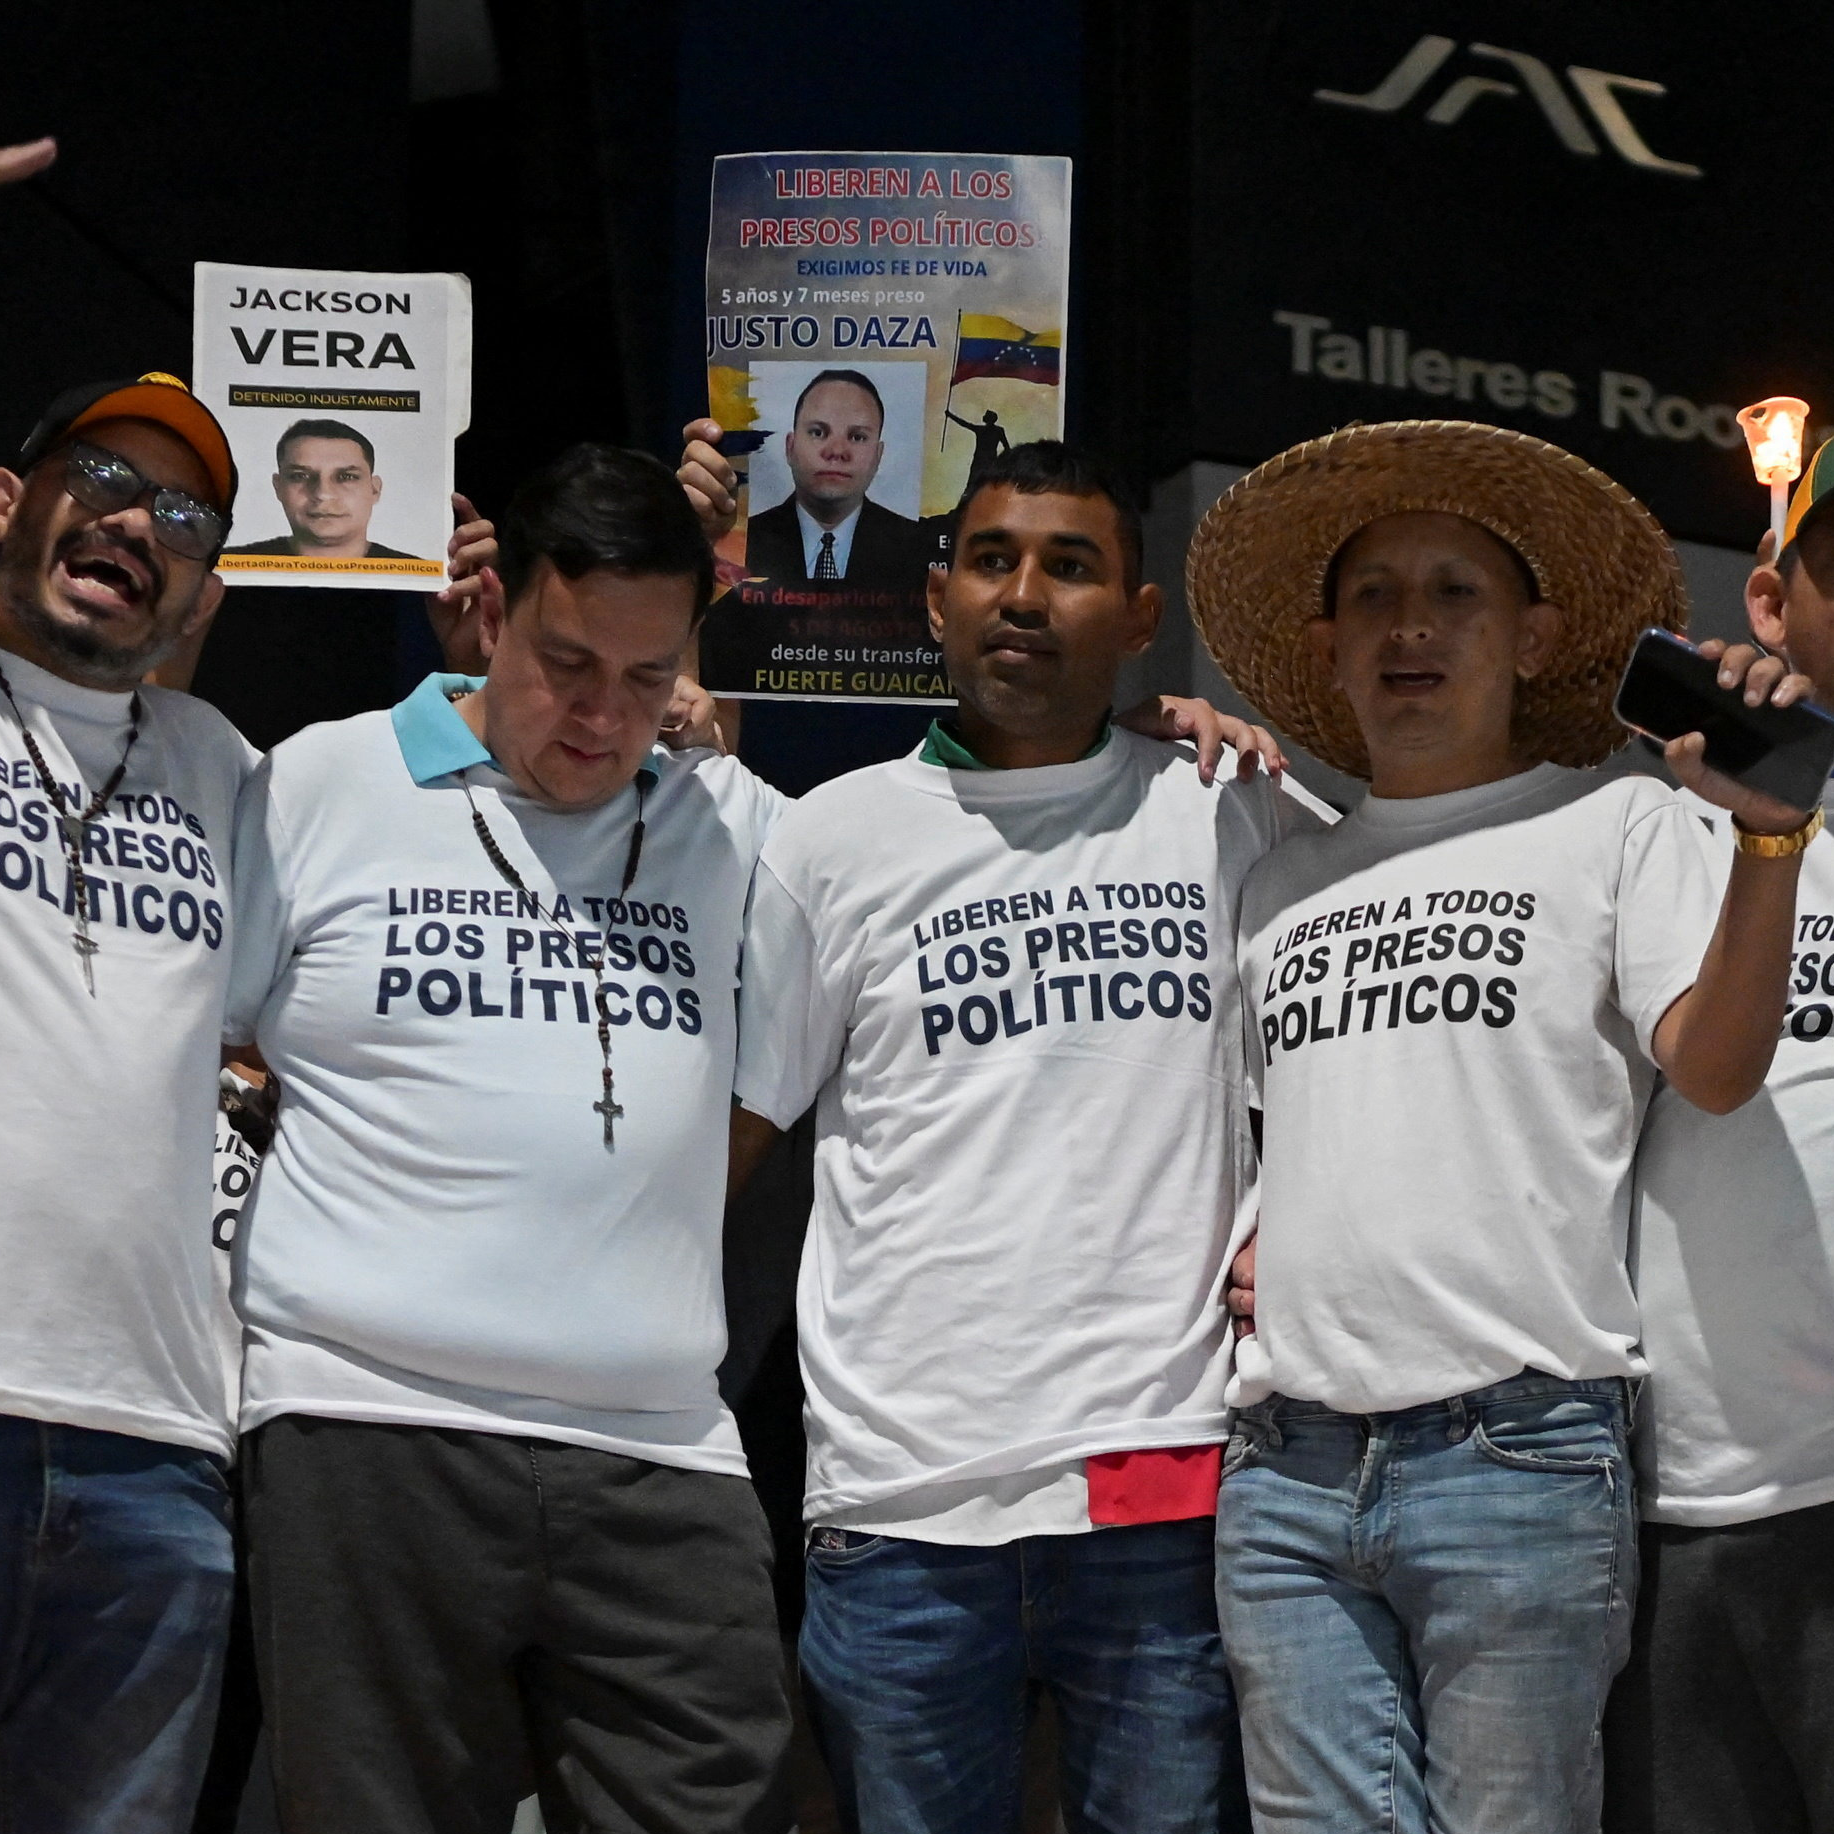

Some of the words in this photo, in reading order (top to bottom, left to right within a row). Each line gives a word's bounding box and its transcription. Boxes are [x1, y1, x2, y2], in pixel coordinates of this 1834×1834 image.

[776, 169, 911, 200] LIBEREN
[918, 169, 942, 199] A
[950, 171, 1011, 200] LOS
[740, 218, 860, 248] PRESOS
[869, 212, 1036, 249] POLÍTICOS
[797, 260, 885, 276] EXIGIMOS
[891, 260, 911, 275] FE
[916, 260, 939, 276] DE
[944, 261, 987, 277] VIDA
[229, 287, 411, 314] JACKSON
[721, 289, 730, 303] 5
[735, 287, 777, 304] años
[783, 290, 793, 307] y
[798, 288, 807, 302] 7
[814, 289, 869, 303] meses
[874, 289, 925, 307] preso
[230, 326, 415, 369] VERA
[708, 316, 819, 356] JUSTO
[833, 315, 937, 349] DAZA
[1273, 311, 1579, 418] Talleres
[233, 391, 305, 403] DETENIDO
[310, 394, 415, 407] INJUSTAMENTE
[742, 588, 764, 604] En
[771, 645, 828, 662] desde
[834, 648, 855, 662] su
[755, 670, 843, 691] FUERTE
[389, 888, 539, 920] LIBEREN
[551, 895, 573, 923] A
[583, 898, 688, 933] TODOS
[914, 889, 1053, 947] LIBEREN
[1067, 885, 1089, 912] A
[1095, 882, 1207, 912] TODOS
[1273, 904, 1384, 960] LIBEREN
[1392, 900, 1412, 922] A
[1425, 889, 1536, 921] TODOS
[386, 922, 485, 959] LOS
[506, 926, 696, 978] PRESOS
[918, 936, 1009, 993] LOS
[1026, 919, 1208, 973] PRESOS
[1263, 947, 1328, 1005] LOS
[1344, 924, 1525, 979] PRESOS
[375, 966, 703, 1036] POLÍTICOS
[922, 969, 1212, 1056] POLÍTICOS
[1262, 974, 1517, 1066] POLÍTICOS
